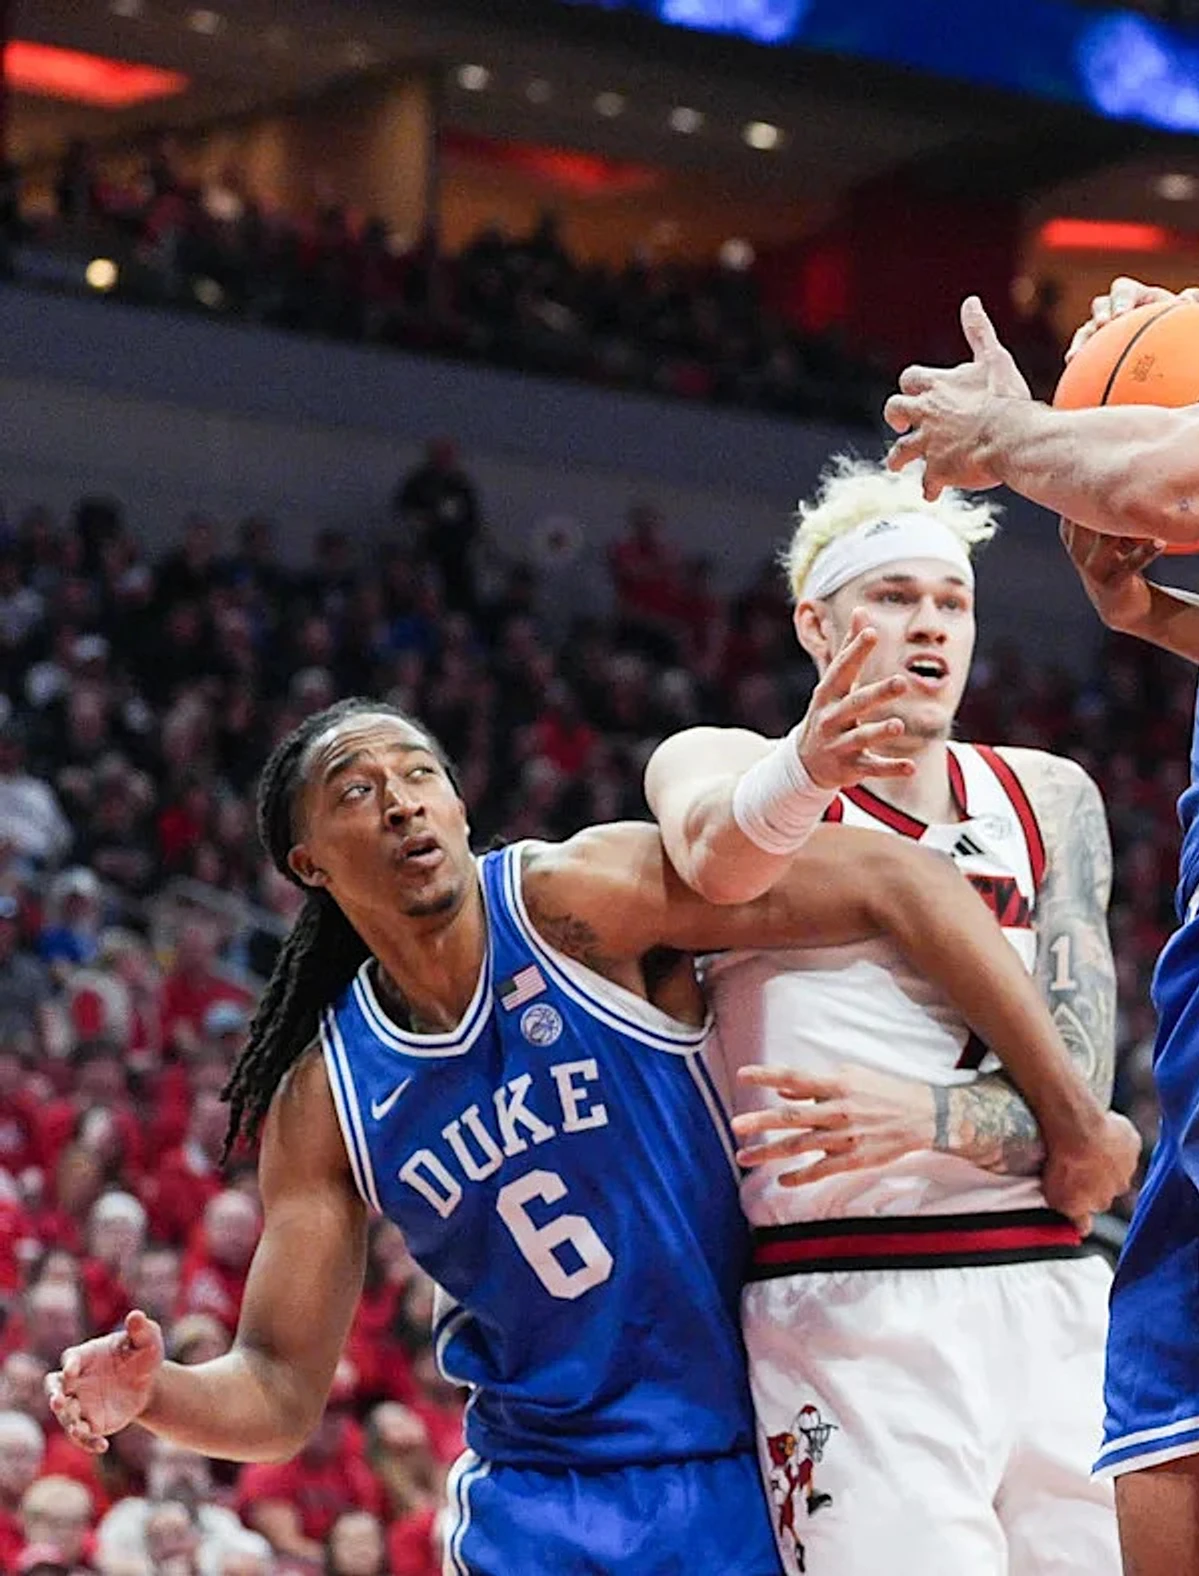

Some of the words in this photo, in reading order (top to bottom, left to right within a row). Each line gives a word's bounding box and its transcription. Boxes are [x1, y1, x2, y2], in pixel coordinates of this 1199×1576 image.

[1050, 933, 1077, 992] 1
[399, 1058, 609, 1220] DUKE
[496, 1169, 614, 1300] 6
